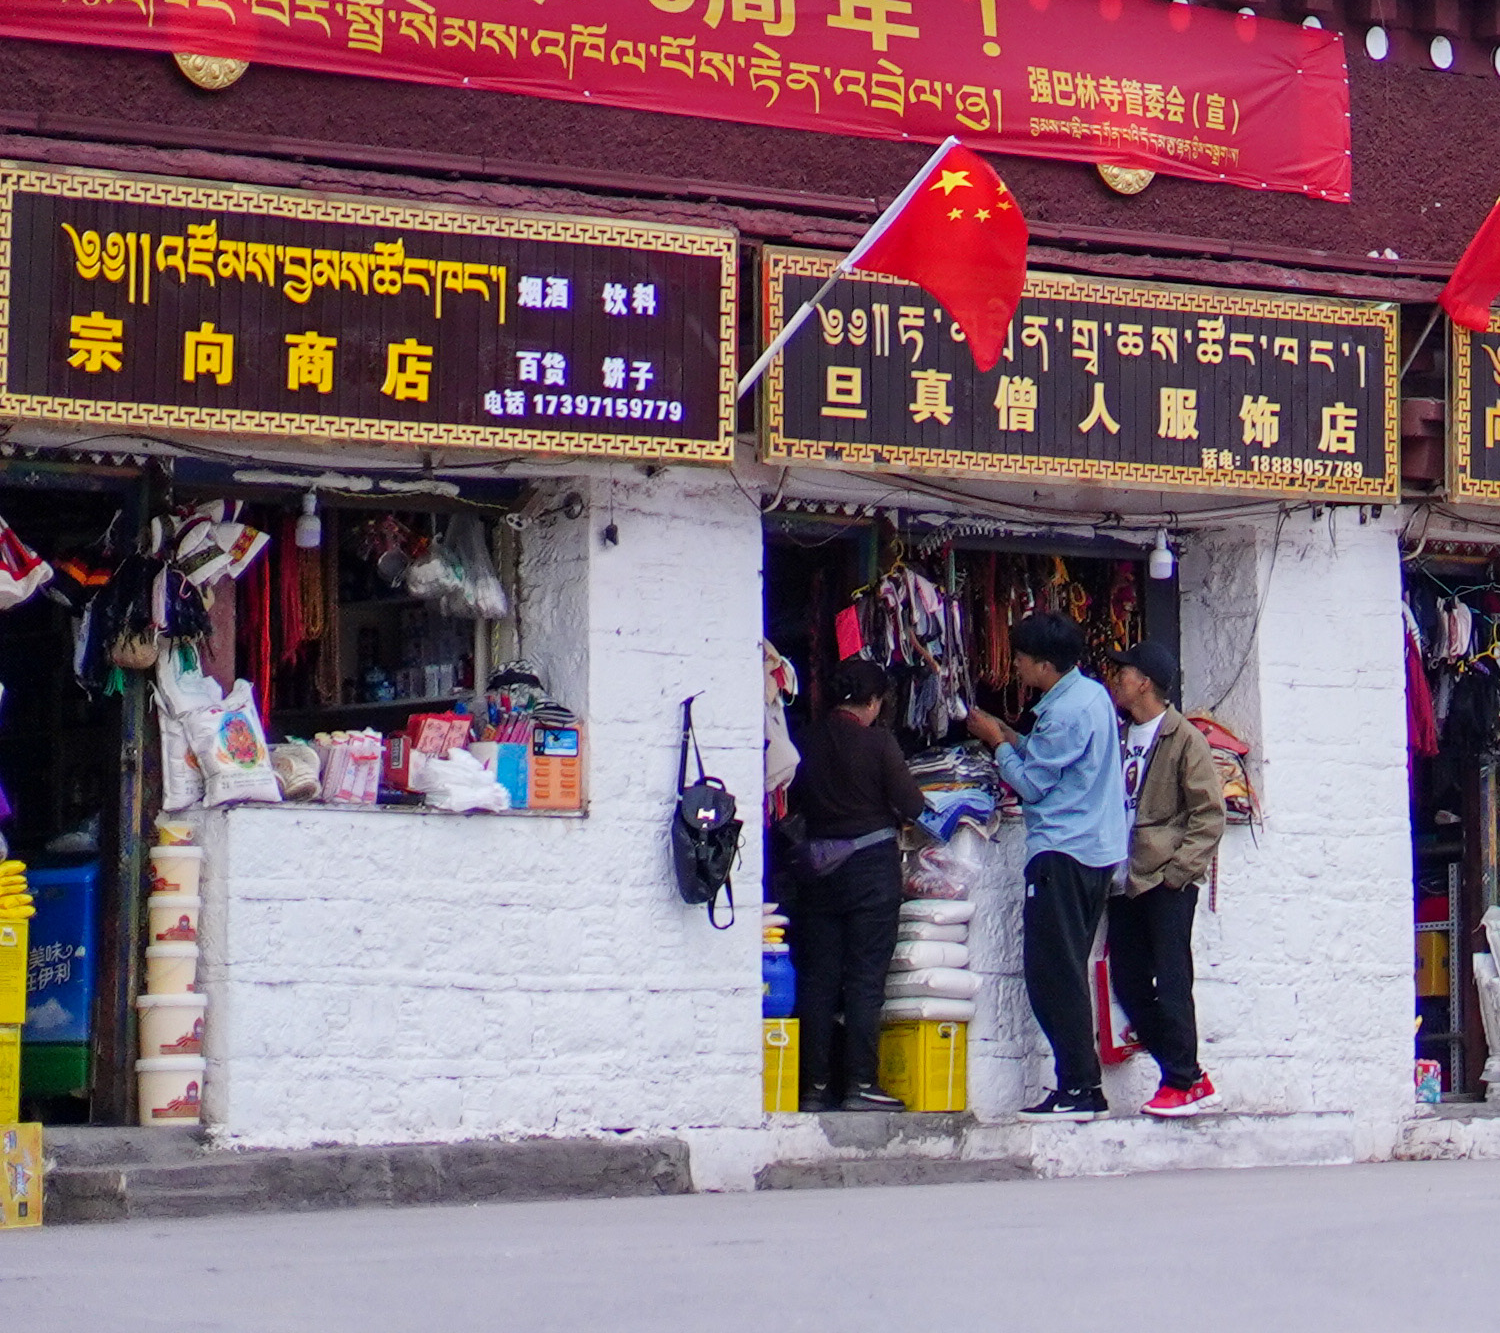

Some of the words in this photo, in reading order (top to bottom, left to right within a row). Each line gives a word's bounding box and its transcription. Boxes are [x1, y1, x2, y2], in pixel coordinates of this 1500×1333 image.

[516, 276, 570, 311] 烟酒
[602, 281, 657, 317] 饮料
[67, 311, 434, 402] 宗向商店
[516, 350, 566, 387] 百货
[602, 355, 655, 390] 饼子
[483, 389, 526, 417] 电话
[532, 393, 684, 422] 17397159779
[821, 365, 1358, 454] 旦真僧人服饰店
[1251, 454, 1364, 480] 18889057789
